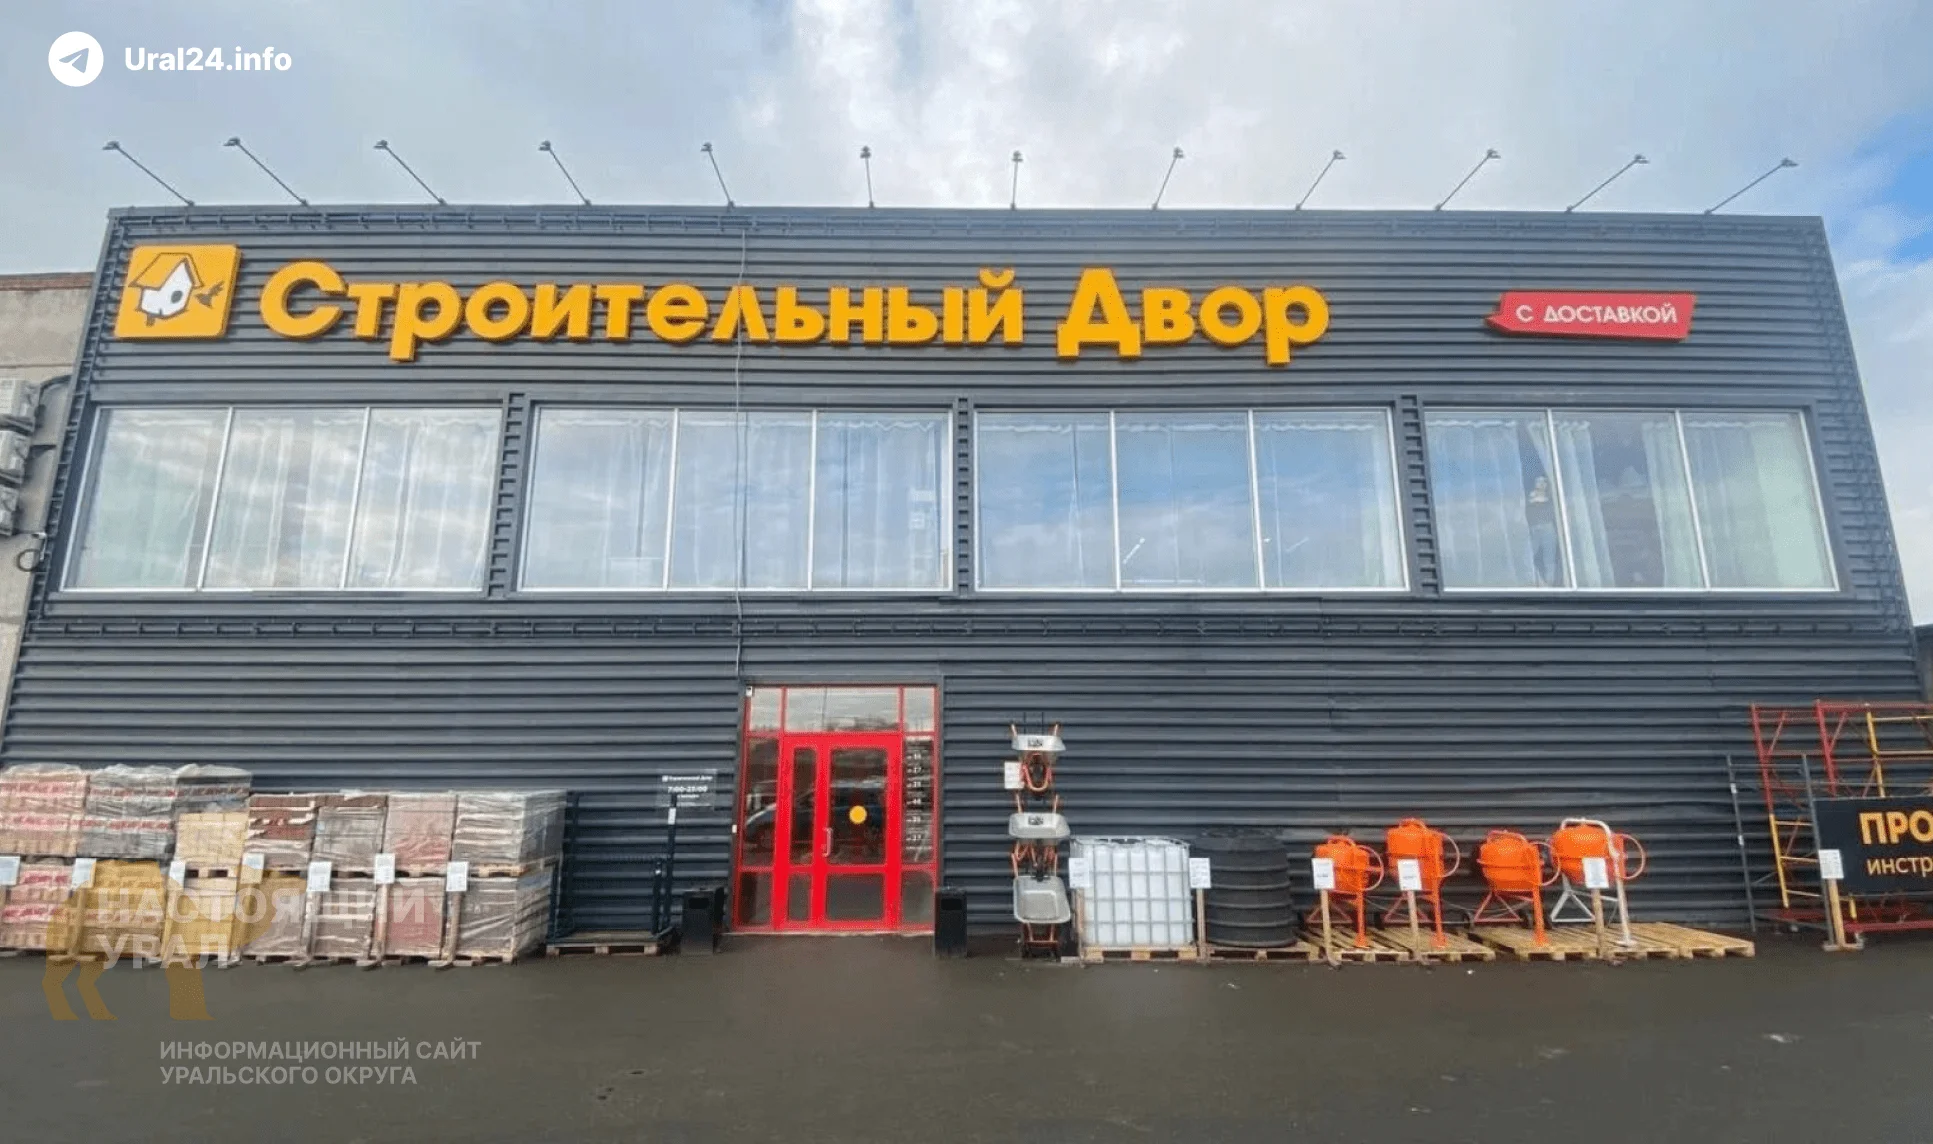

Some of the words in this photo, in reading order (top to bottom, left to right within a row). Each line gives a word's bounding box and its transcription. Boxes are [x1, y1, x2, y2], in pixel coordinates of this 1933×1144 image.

[259, 260, 1024, 361] Строительный
[1056, 267, 1330, 365] Двор
[1515, 304, 1534, 323] С
[1543, 302, 1678, 324] ДОСТАВКОЙ
[1859, 810, 1933, 845] ПРО
[1867, 856, 1933, 878] инстр
